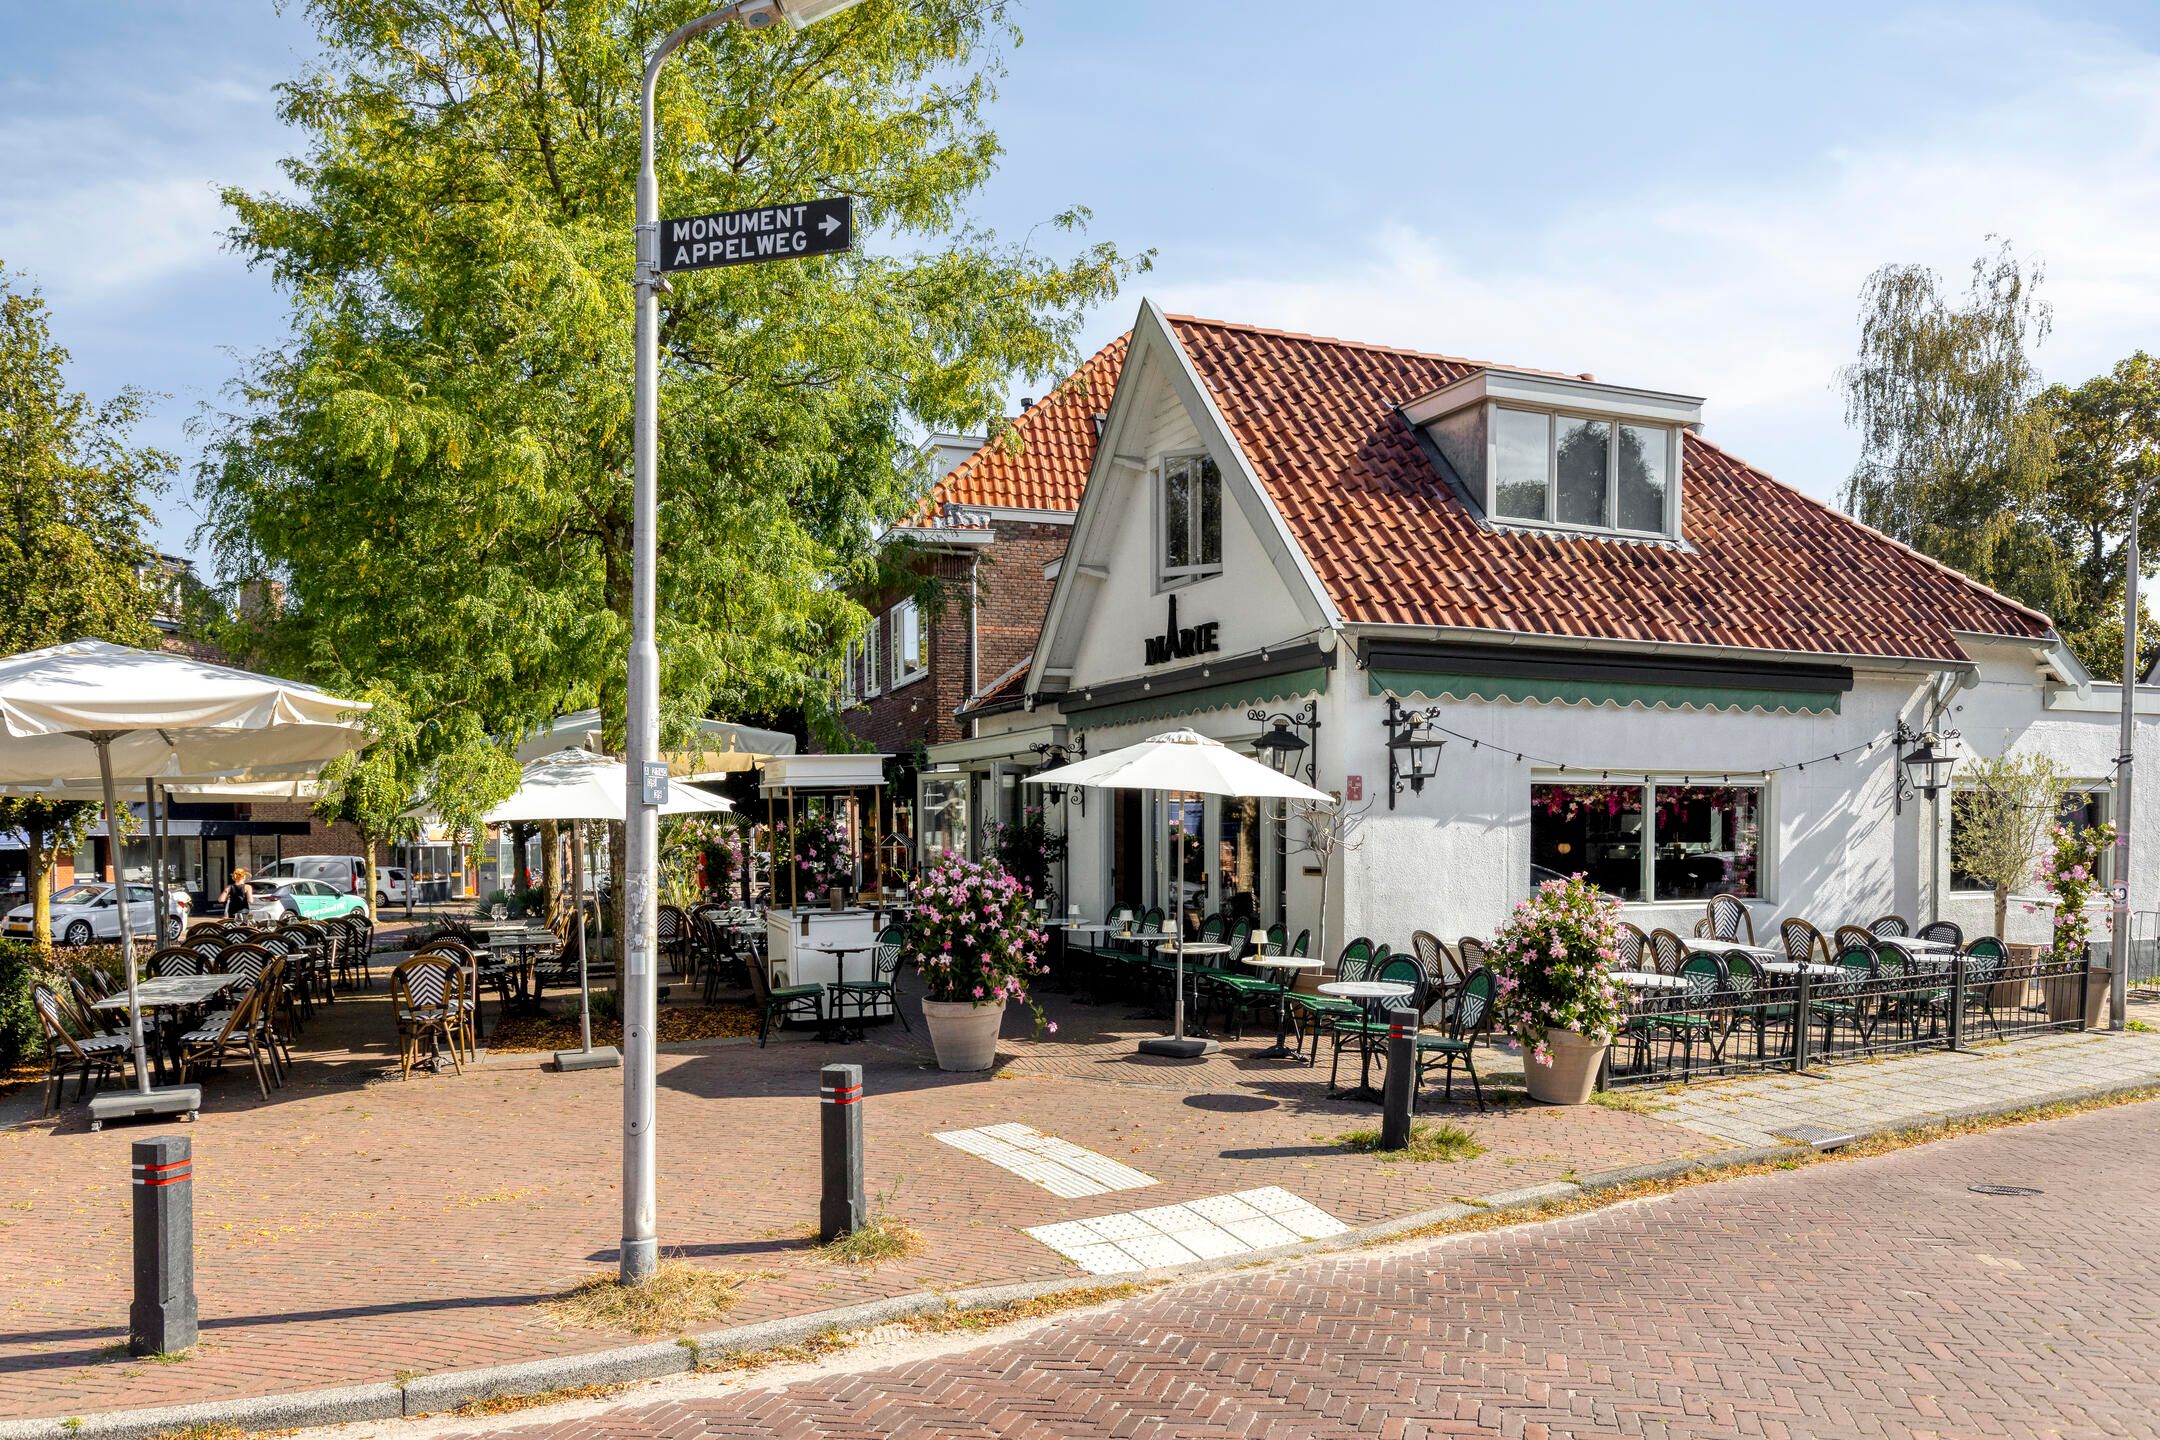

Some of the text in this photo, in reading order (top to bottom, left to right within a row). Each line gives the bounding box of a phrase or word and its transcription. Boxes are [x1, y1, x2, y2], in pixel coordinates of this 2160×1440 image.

[672, 205, 808, 243] MONUMENT
[673, 231, 808, 266] APPELWEG
[1144, 593, 1220, 666] MARIE
